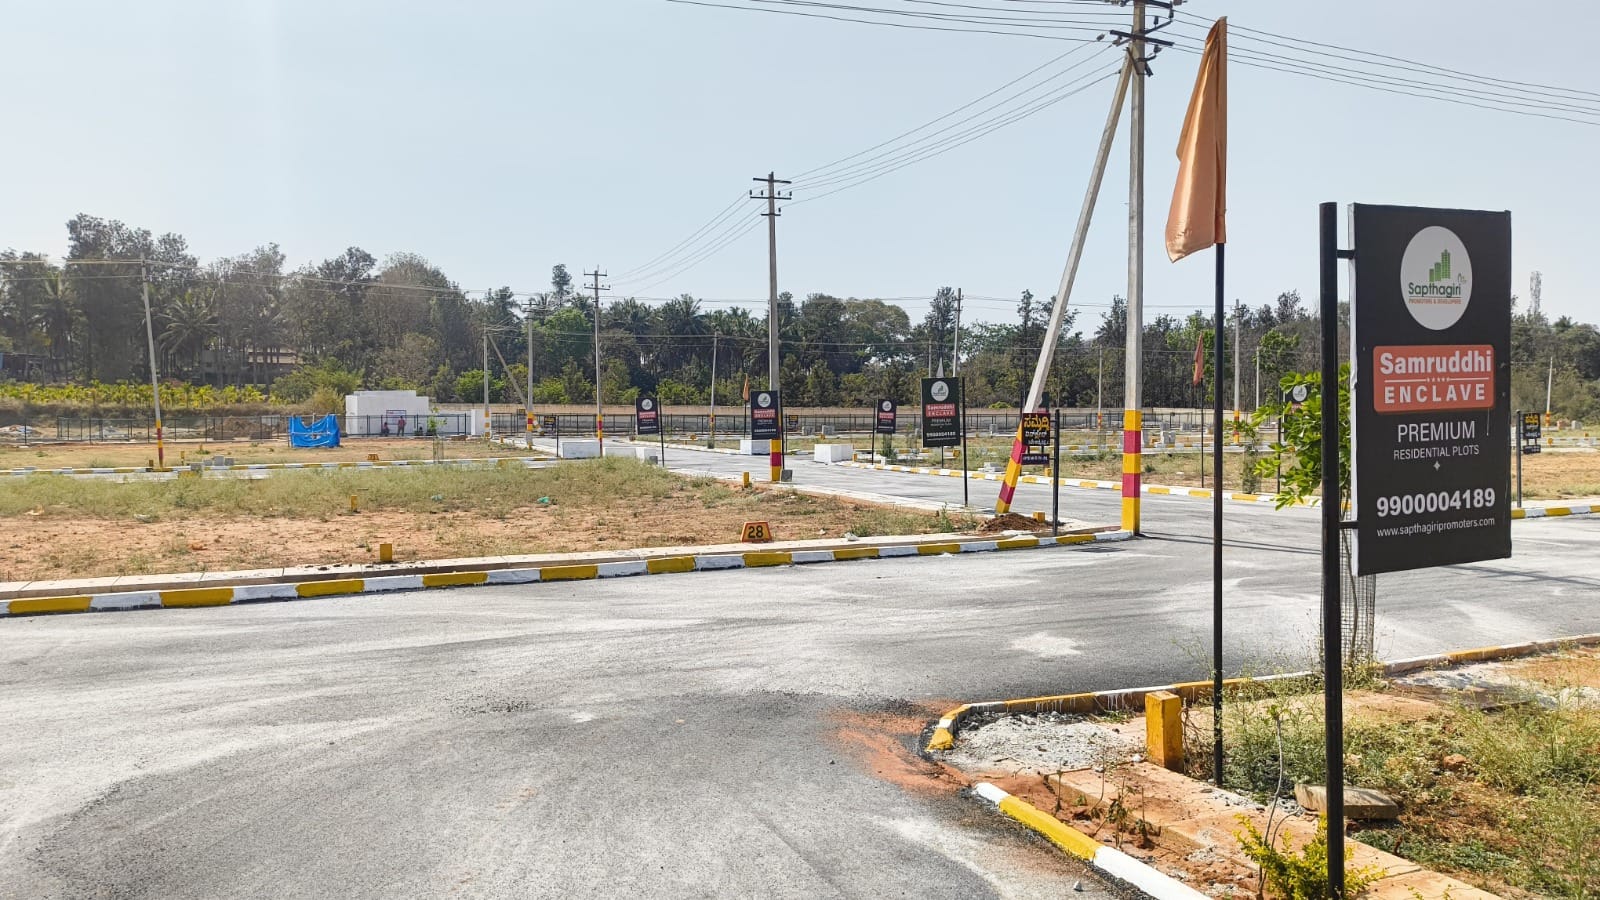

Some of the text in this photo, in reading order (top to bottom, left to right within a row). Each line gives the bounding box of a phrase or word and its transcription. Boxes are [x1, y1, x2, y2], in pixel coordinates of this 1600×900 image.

[1408, 282, 1461, 298] Sapthagiri
[1380, 350, 1491, 374] Samruddhi
[1384, 384, 1485, 404] ENCLAVE
[1398, 421, 1475, 442] PREMIUM
[1394, 444, 1480, 460] RESIDENTIAL PLOTS
[1376, 488, 1496, 517] 9900004189
[748, 525, 763, 538] 28
[1377, 517, 1495, 537] www.sapthagiripromoters.com
